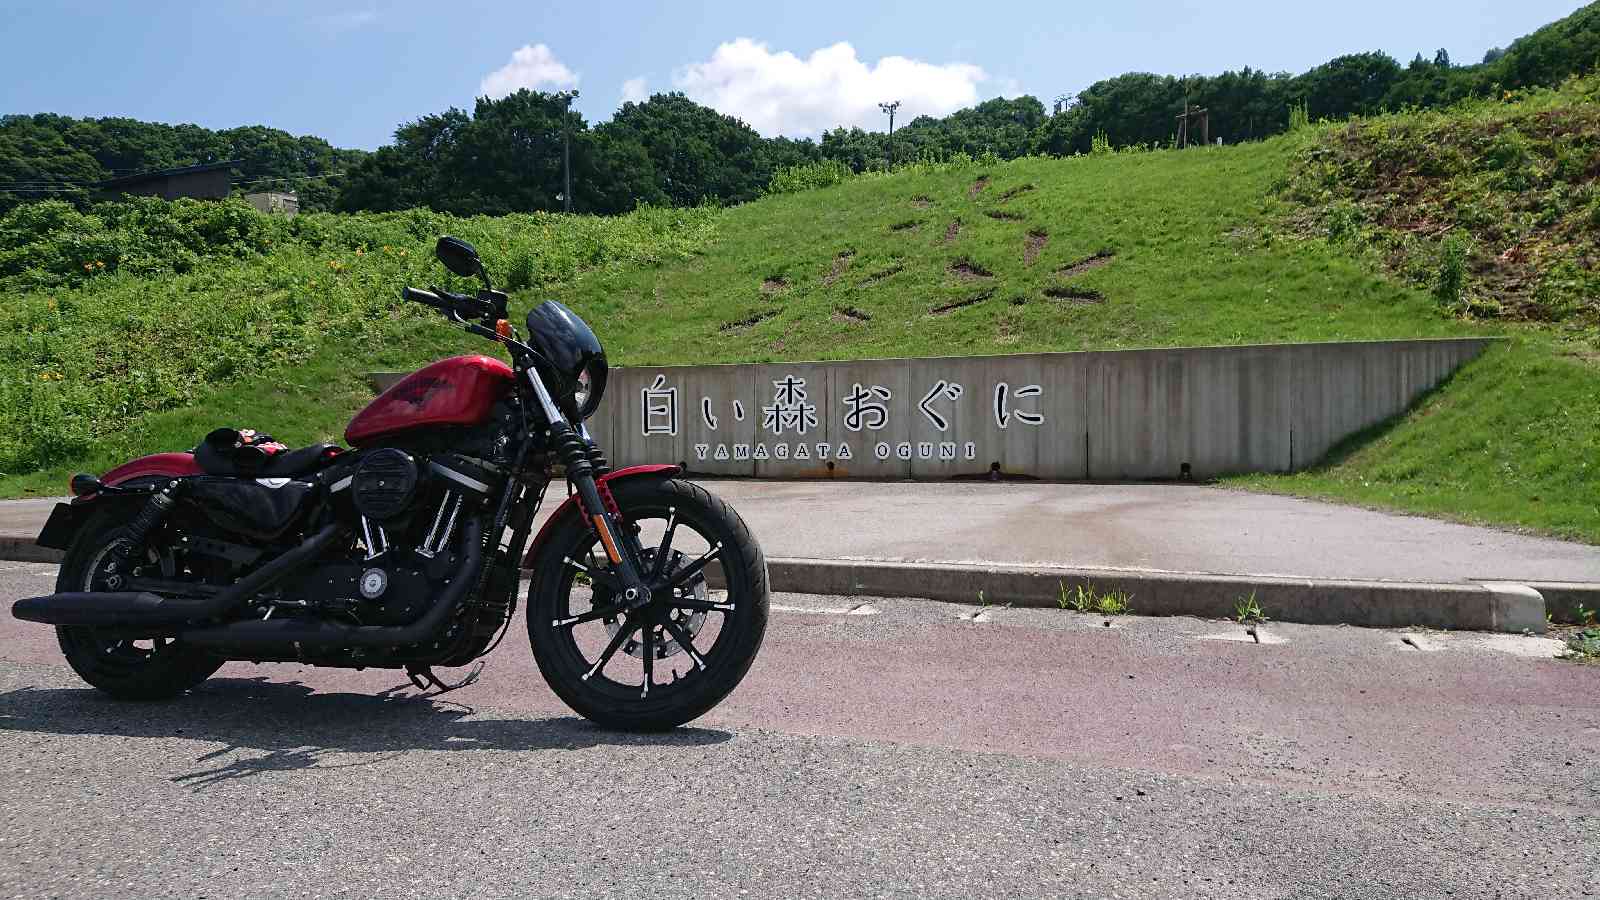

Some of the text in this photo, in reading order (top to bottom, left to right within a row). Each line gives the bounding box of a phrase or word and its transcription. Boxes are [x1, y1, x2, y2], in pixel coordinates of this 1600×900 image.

[642, 375, 1045, 435] 白い森おぐに
[695, 442, 976, 460] YAMAGATA OGUNI
